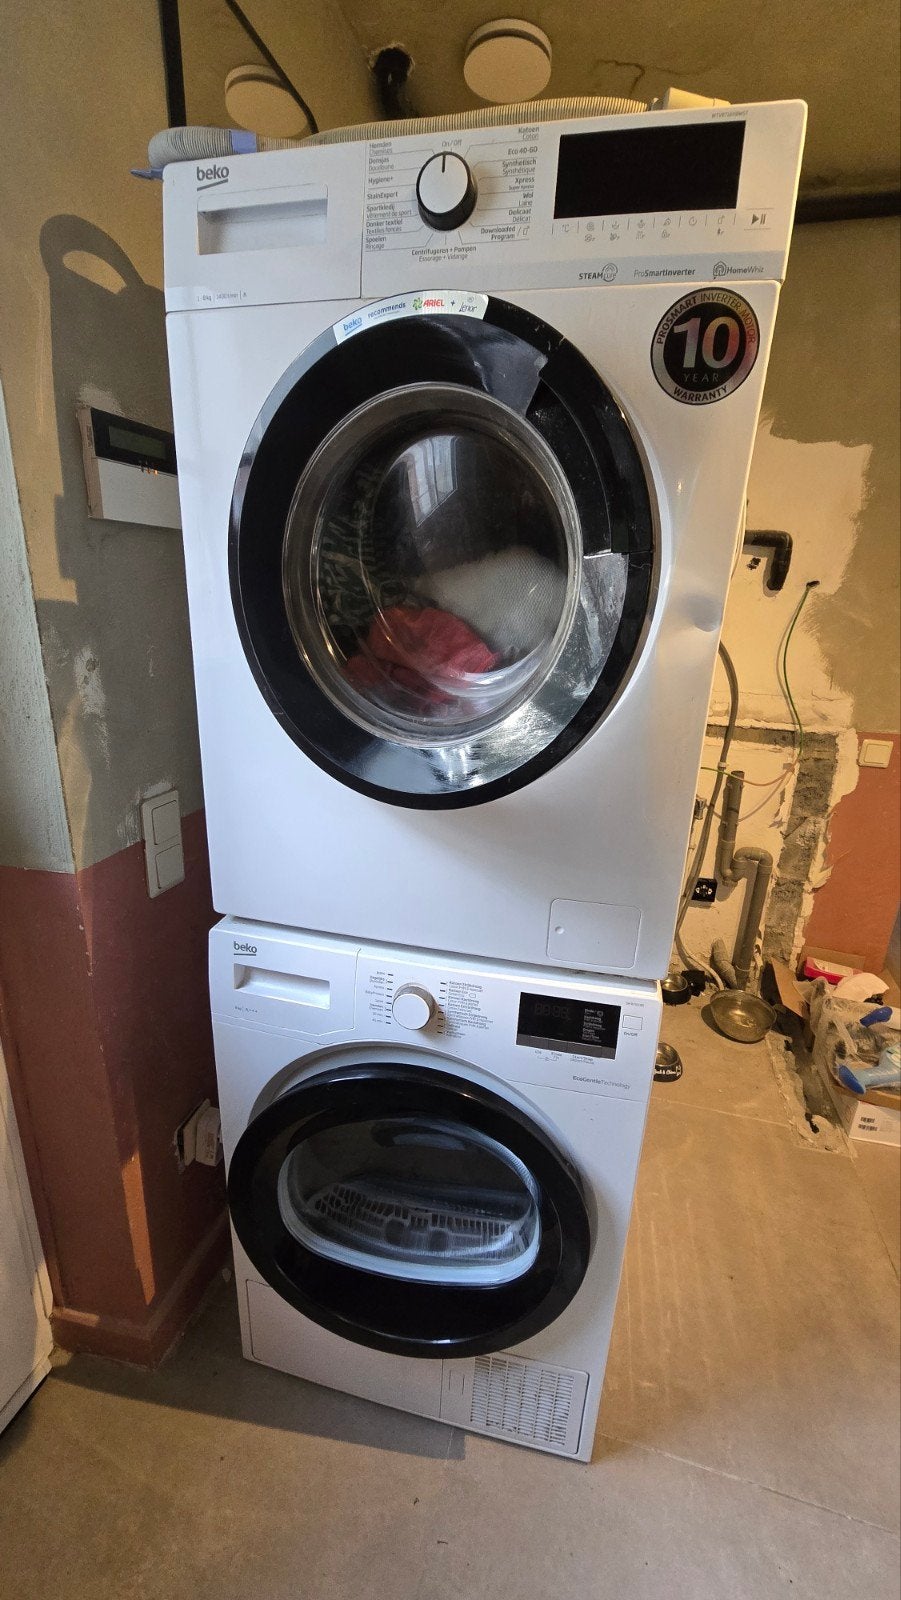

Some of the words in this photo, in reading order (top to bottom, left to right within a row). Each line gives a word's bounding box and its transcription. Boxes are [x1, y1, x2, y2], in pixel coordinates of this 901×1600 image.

[502, 158, 536, 168] Synthetisch
[197, 164, 229, 181] beko
[481, 226, 516, 234] Downloaded
[411, 248, 449, 256] Centrifugeren
[633, 268, 695, 277] ProSmartInverter
[727, 265, 764, 274] HomeWhiz
[578, 272, 603, 280] STEAM
[423, 299, 445, 307] ARIEL
[343, 317, 362, 331] beko
[368, 302, 406, 318] recommends
[656, 295, 697, 345] PROSMART
[700, 293, 742, 311] INVERTER
[741, 309, 756, 344] MOTOR
[673, 316, 740, 369] 10
[682, 373, 719, 382] YEAR
[673, 385, 728, 402] WARRANTY
[234, 941, 257, 953] beko
